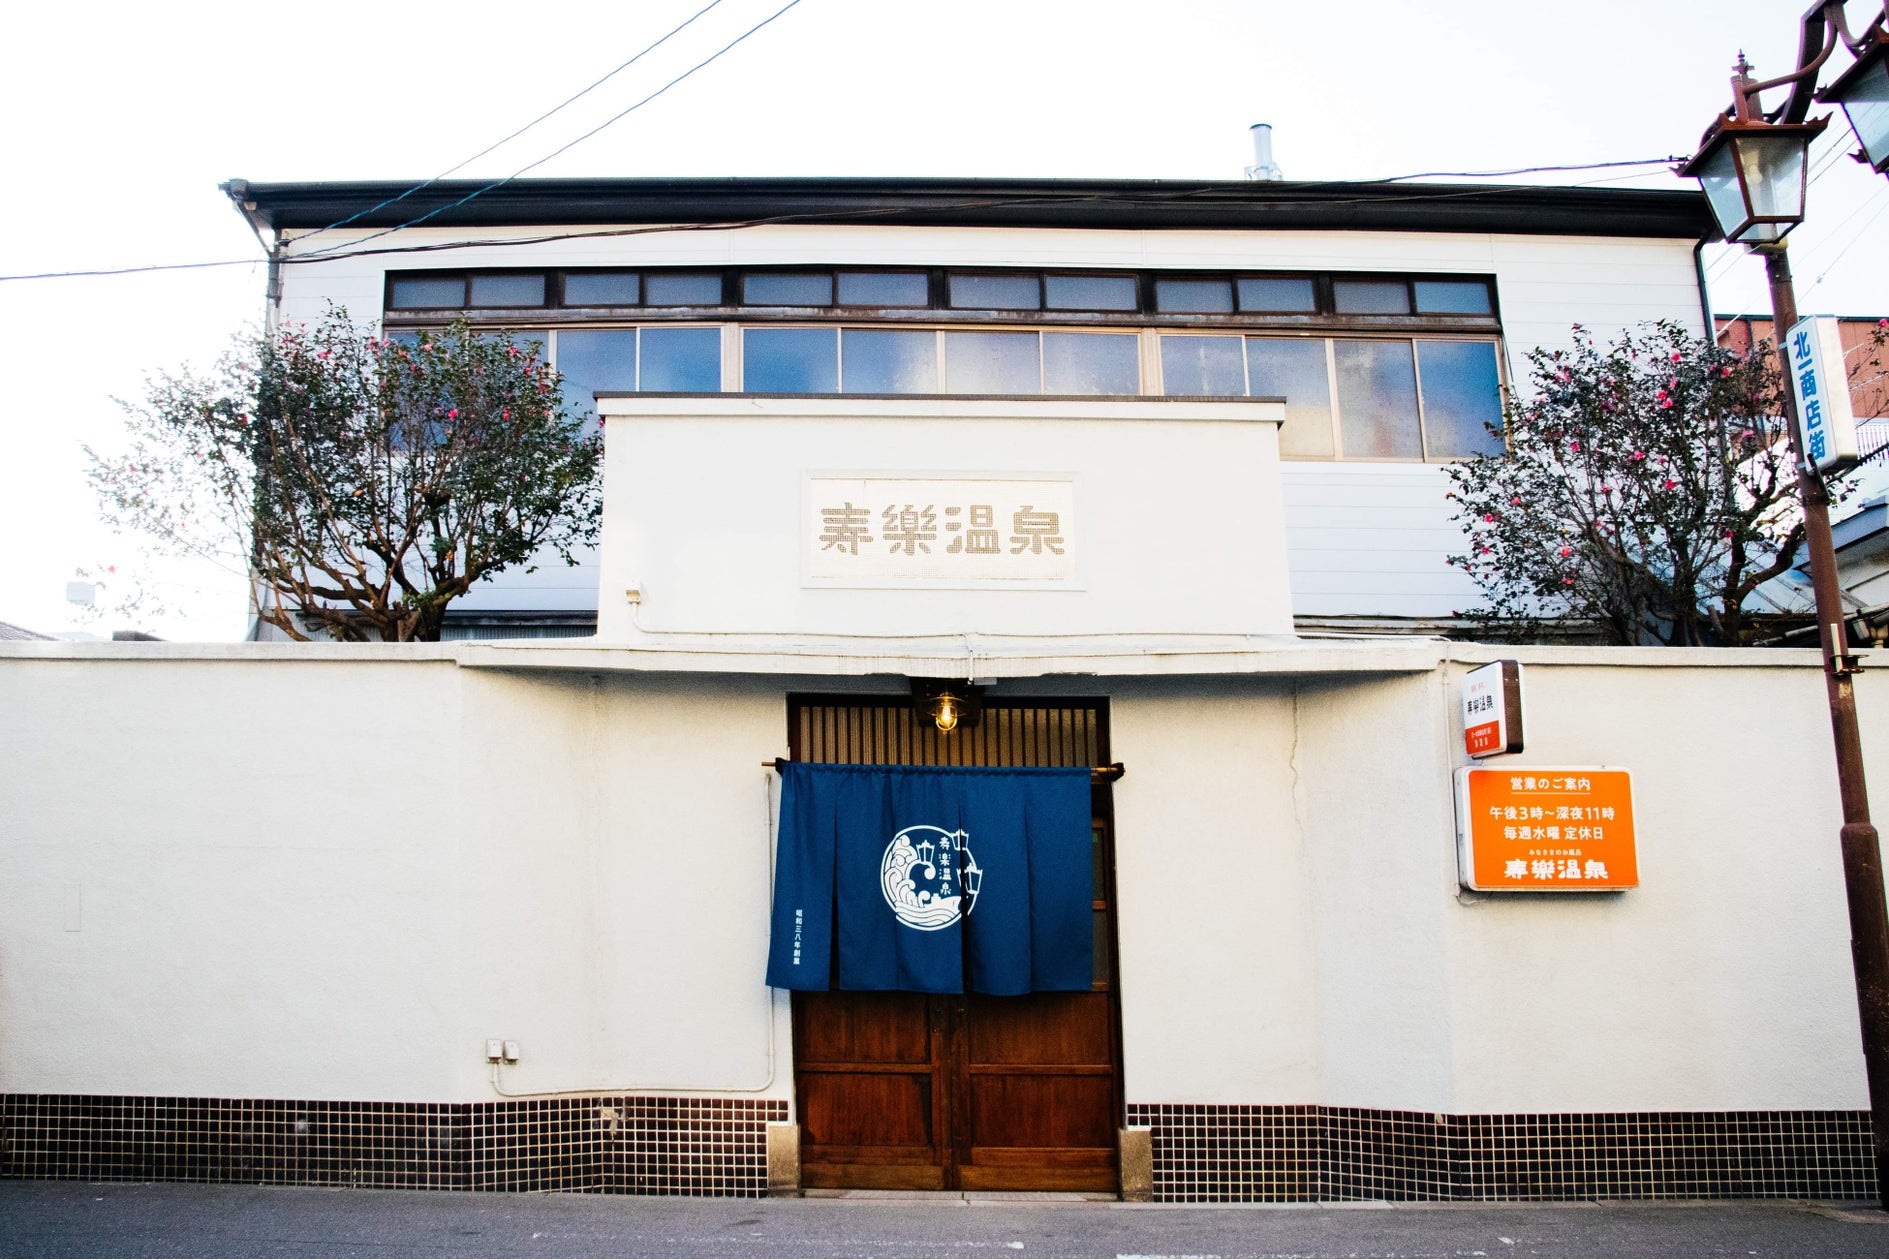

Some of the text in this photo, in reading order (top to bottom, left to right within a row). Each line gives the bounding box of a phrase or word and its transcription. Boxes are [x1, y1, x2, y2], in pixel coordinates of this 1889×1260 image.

[1793, 331, 1826, 461] 北一商店街
[1511, 776, 1591, 791] 営業のご案内
[1503, 825, 1604, 840] 毎週水曜 定休日
[793, 909, 803, 965] 昭和三八年創業
